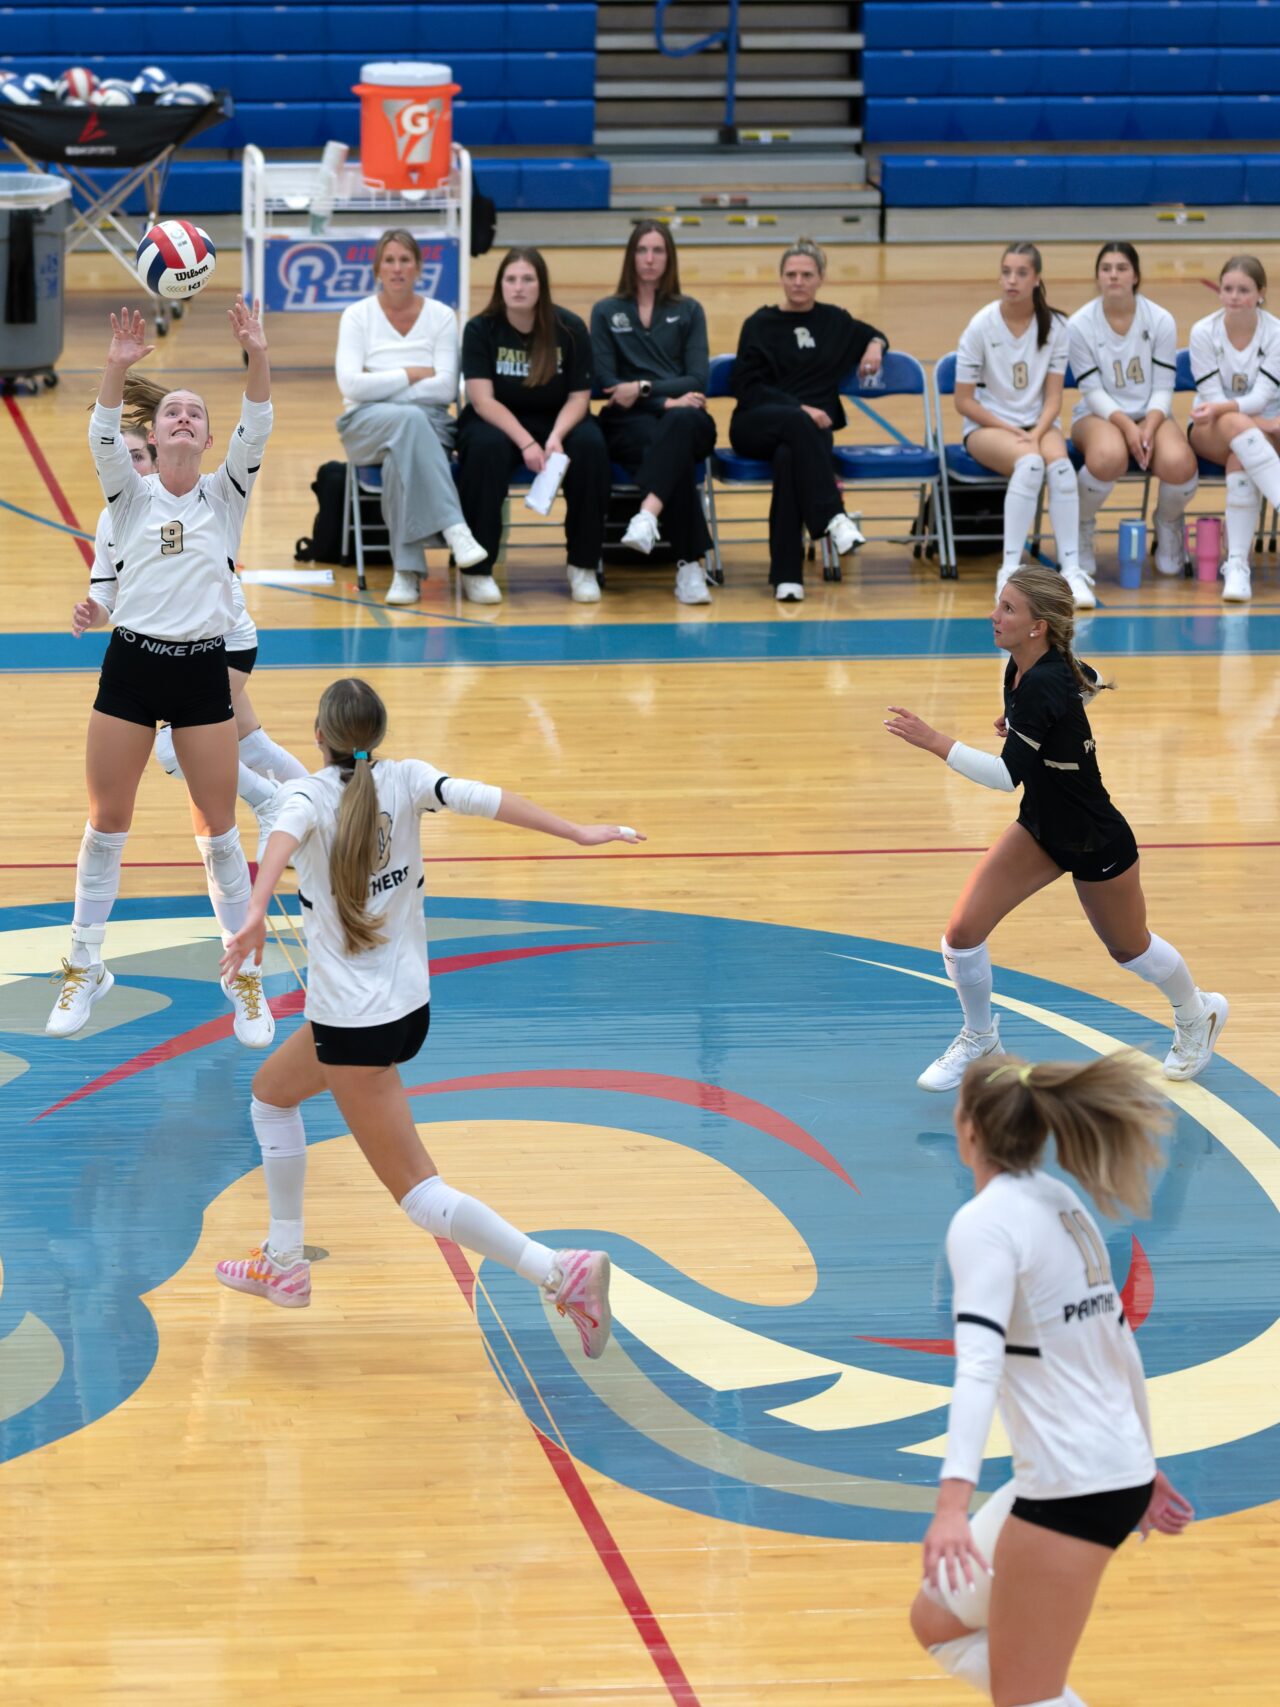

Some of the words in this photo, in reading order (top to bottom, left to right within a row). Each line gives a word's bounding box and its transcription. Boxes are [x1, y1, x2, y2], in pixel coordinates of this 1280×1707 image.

[402, 104, 429, 135] G
[175, 264, 209, 281] Wilson
[278, 242, 443, 311] Ras
[1013, 361, 1029, 389] 8
[1113, 356, 1144, 388] 14
[161, 520, 184, 555] 9
[141, 638, 188, 657] NIKE
[190, 636, 223, 656] PRO
[1060, 1210, 1111, 1288] 11
